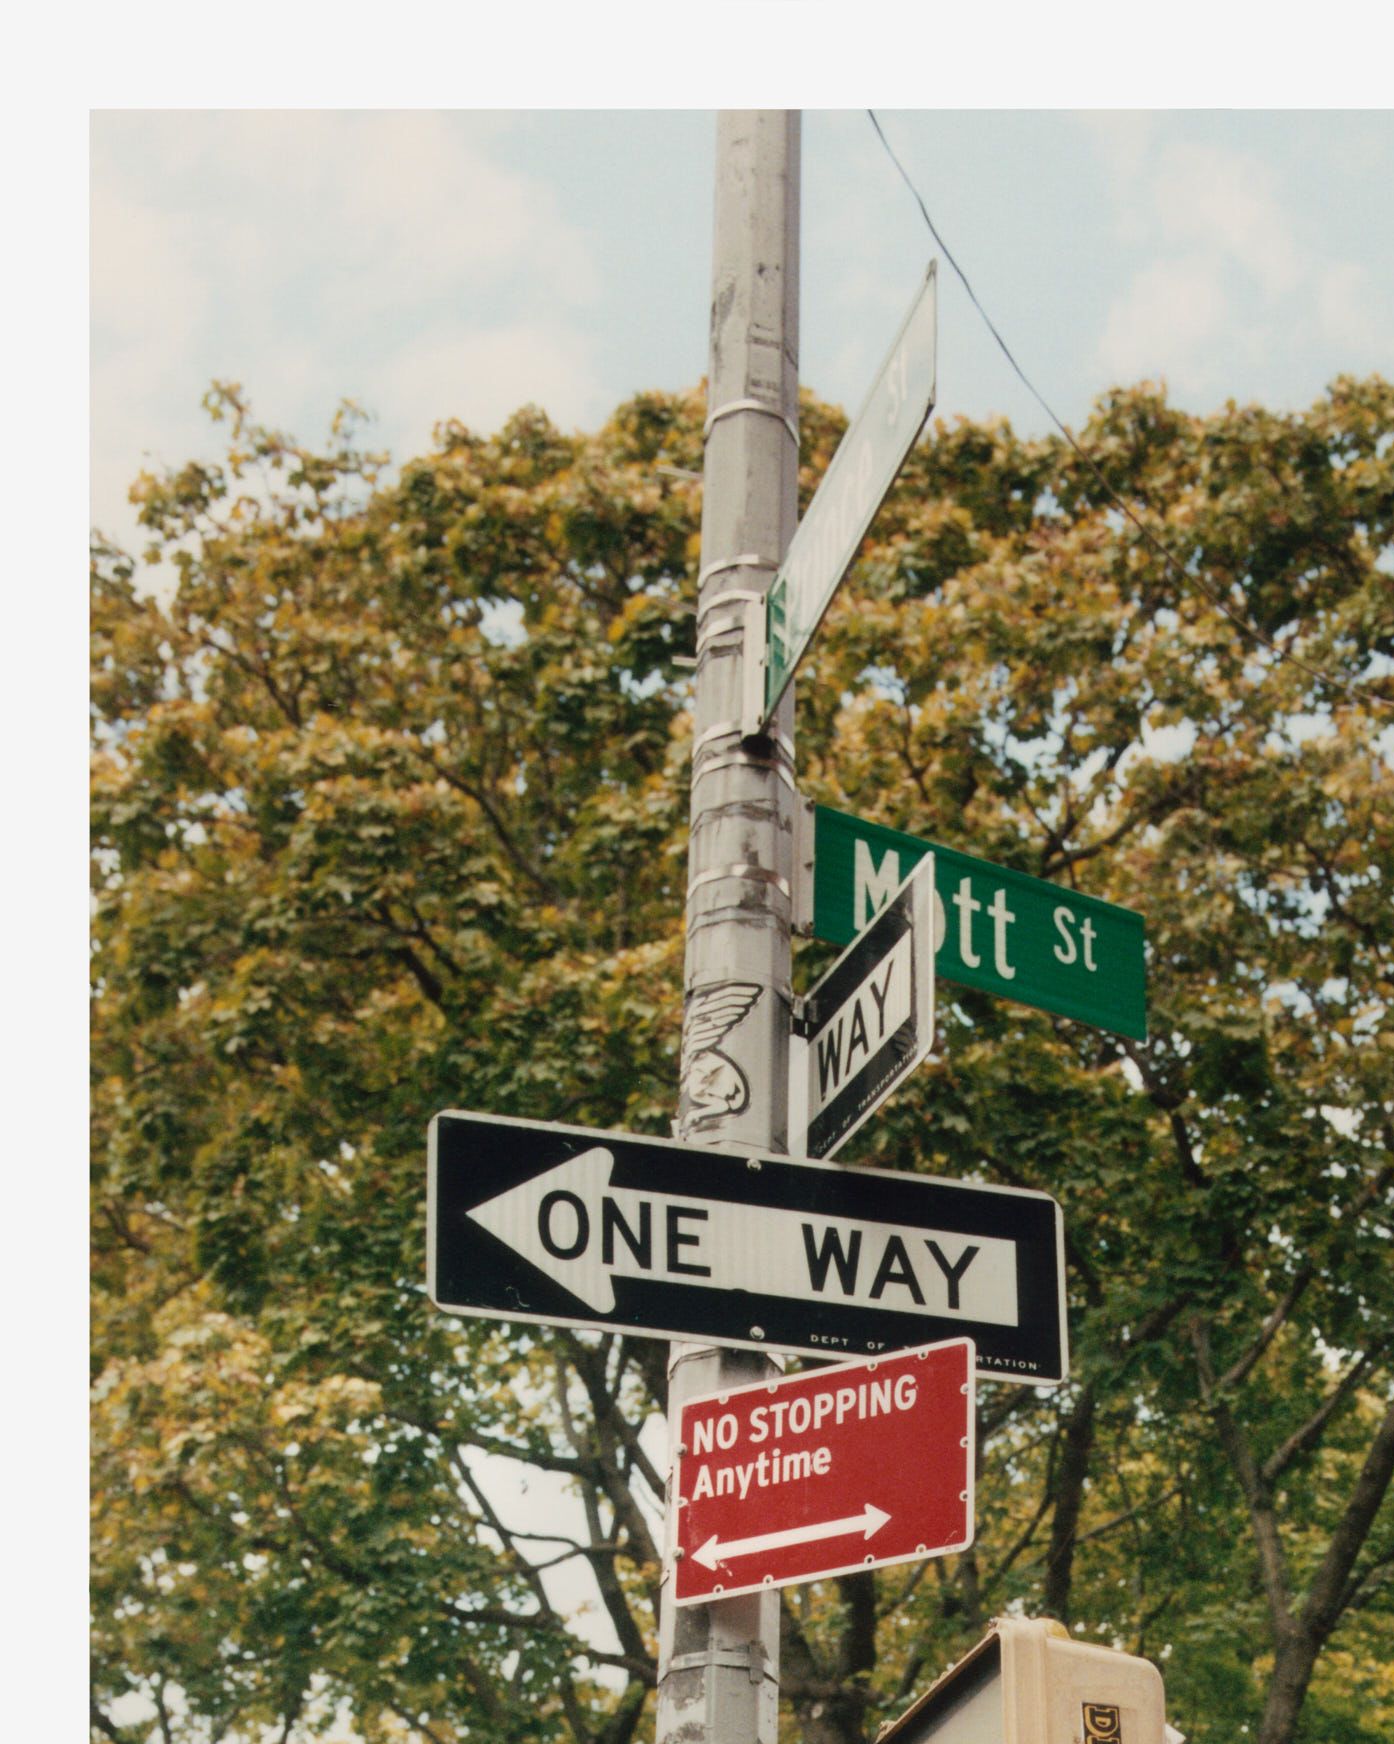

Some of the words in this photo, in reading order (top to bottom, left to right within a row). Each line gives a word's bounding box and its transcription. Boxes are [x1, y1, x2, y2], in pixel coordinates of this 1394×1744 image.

[1053, 906, 1098, 972] St
[817, 959, 894, 1103] WAY
[537, 1189, 712, 1278] ONE
[801, 1223, 980, 1310] WAY
[809, 1334, 849, 1347] DEPT
[867, 1341, 885, 1350] OF
[693, 1413, 739, 1455] NO
[749, 1374, 918, 1443] STOPPING
[692, 1446, 832, 1501] Anytime
